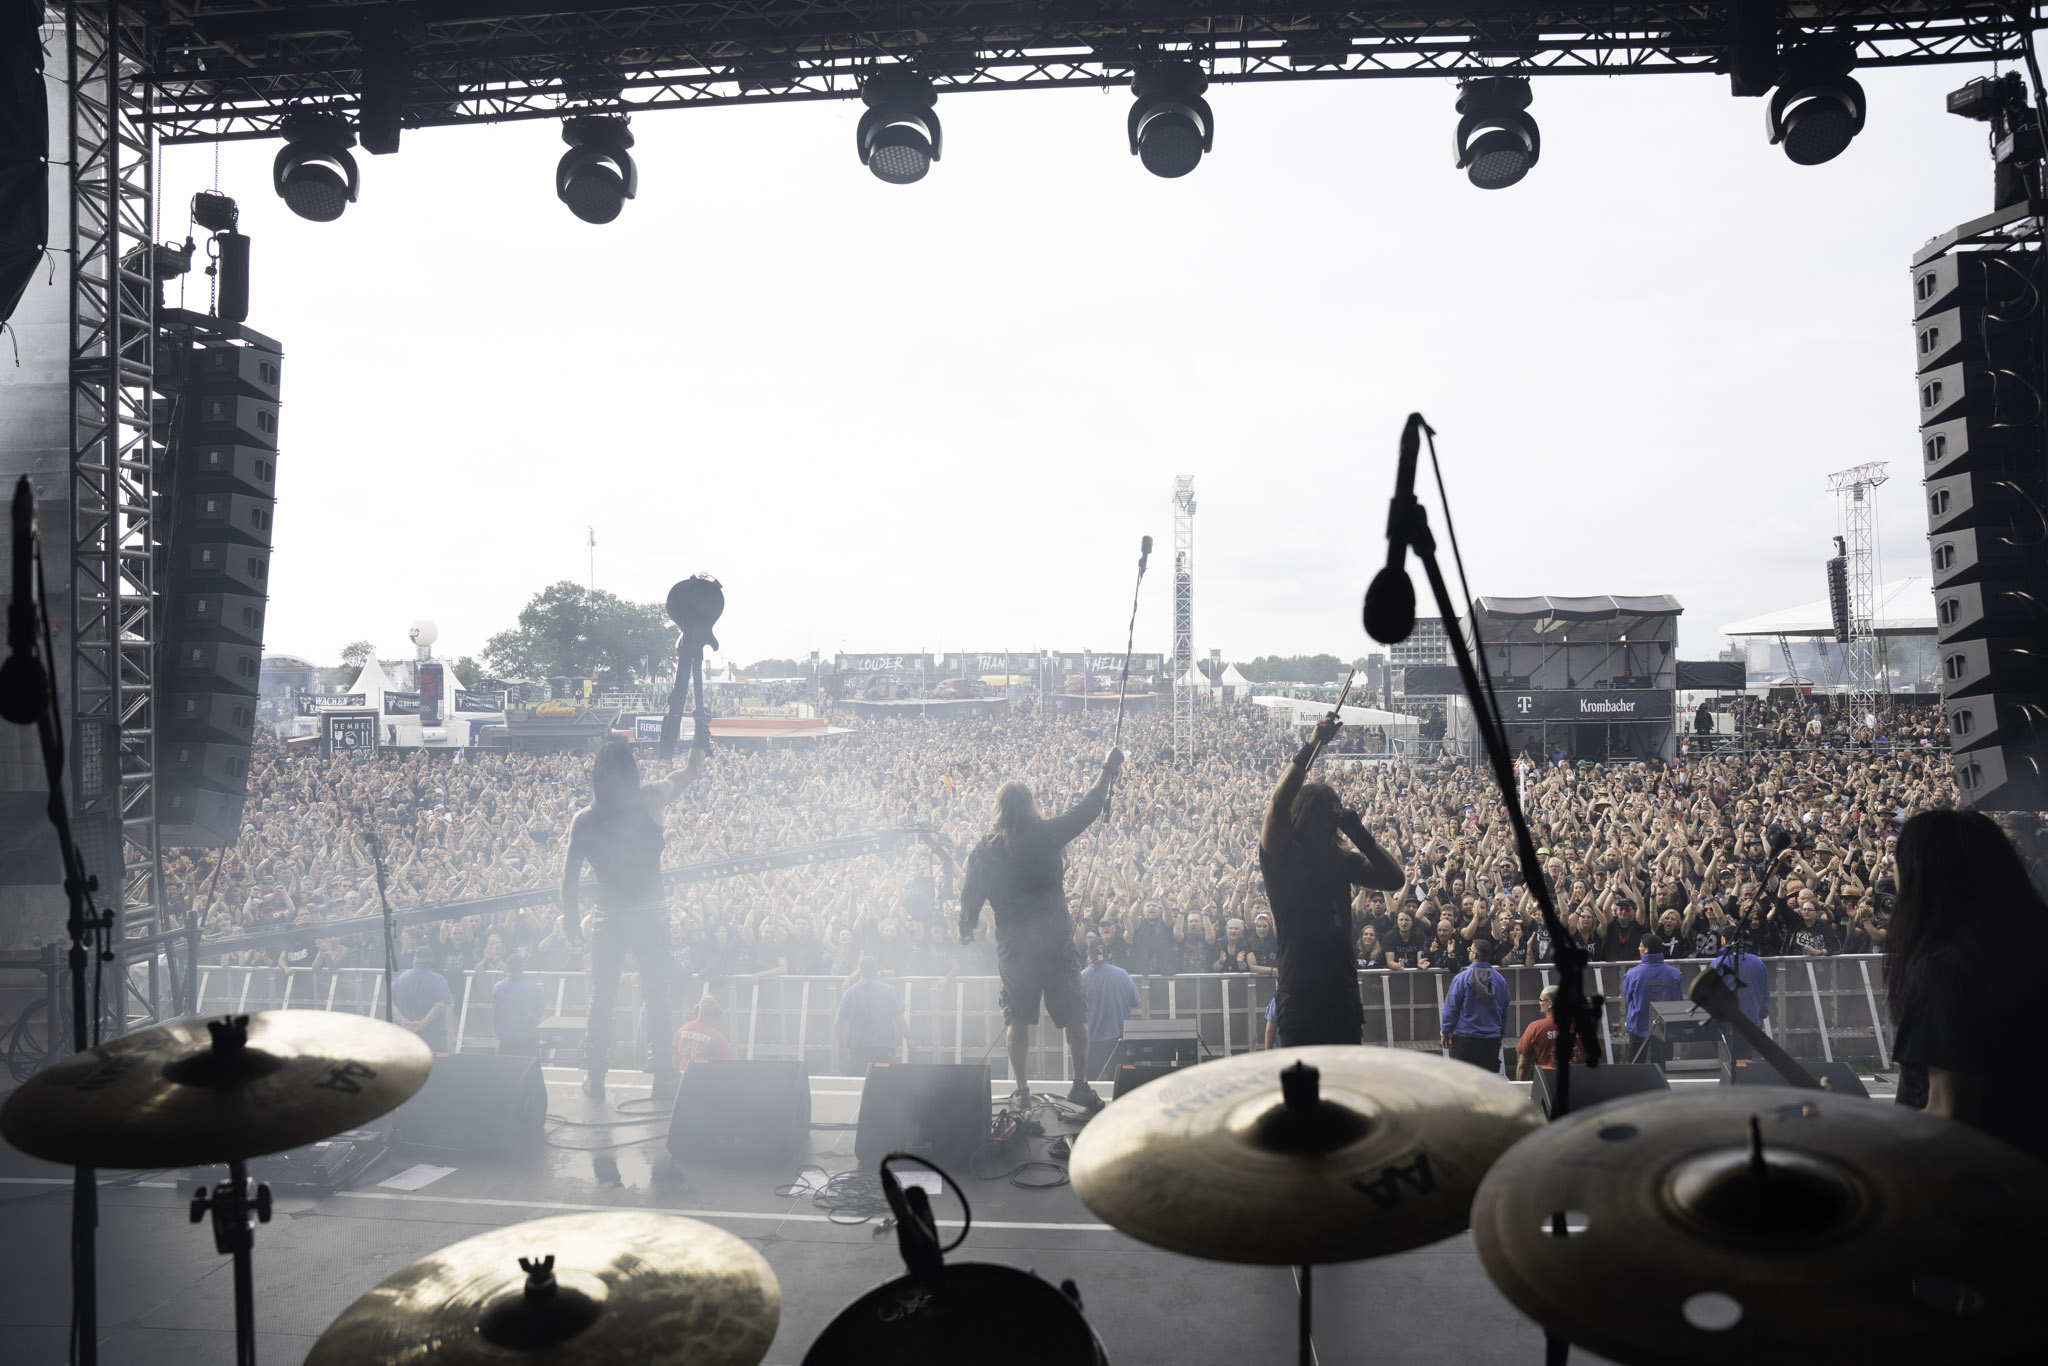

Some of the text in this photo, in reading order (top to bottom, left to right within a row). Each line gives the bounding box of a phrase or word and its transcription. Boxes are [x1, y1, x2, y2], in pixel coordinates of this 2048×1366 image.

[859, 656, 904, 671] LOUDER
[976, 655, 1006, 671] THAN
[1091, 655, 1124, 672] HELL
[315, 696, 349, 706] WACKEN
[1580, 698, 1636, 712] Krombacher
[1300, 711, 1325, 722] Kromb
[334, 722, 371, 730] BEMBEL
[640, 722, 662, 733] FLENSBU
[680, 1029, 713, 1043] SECURITY
